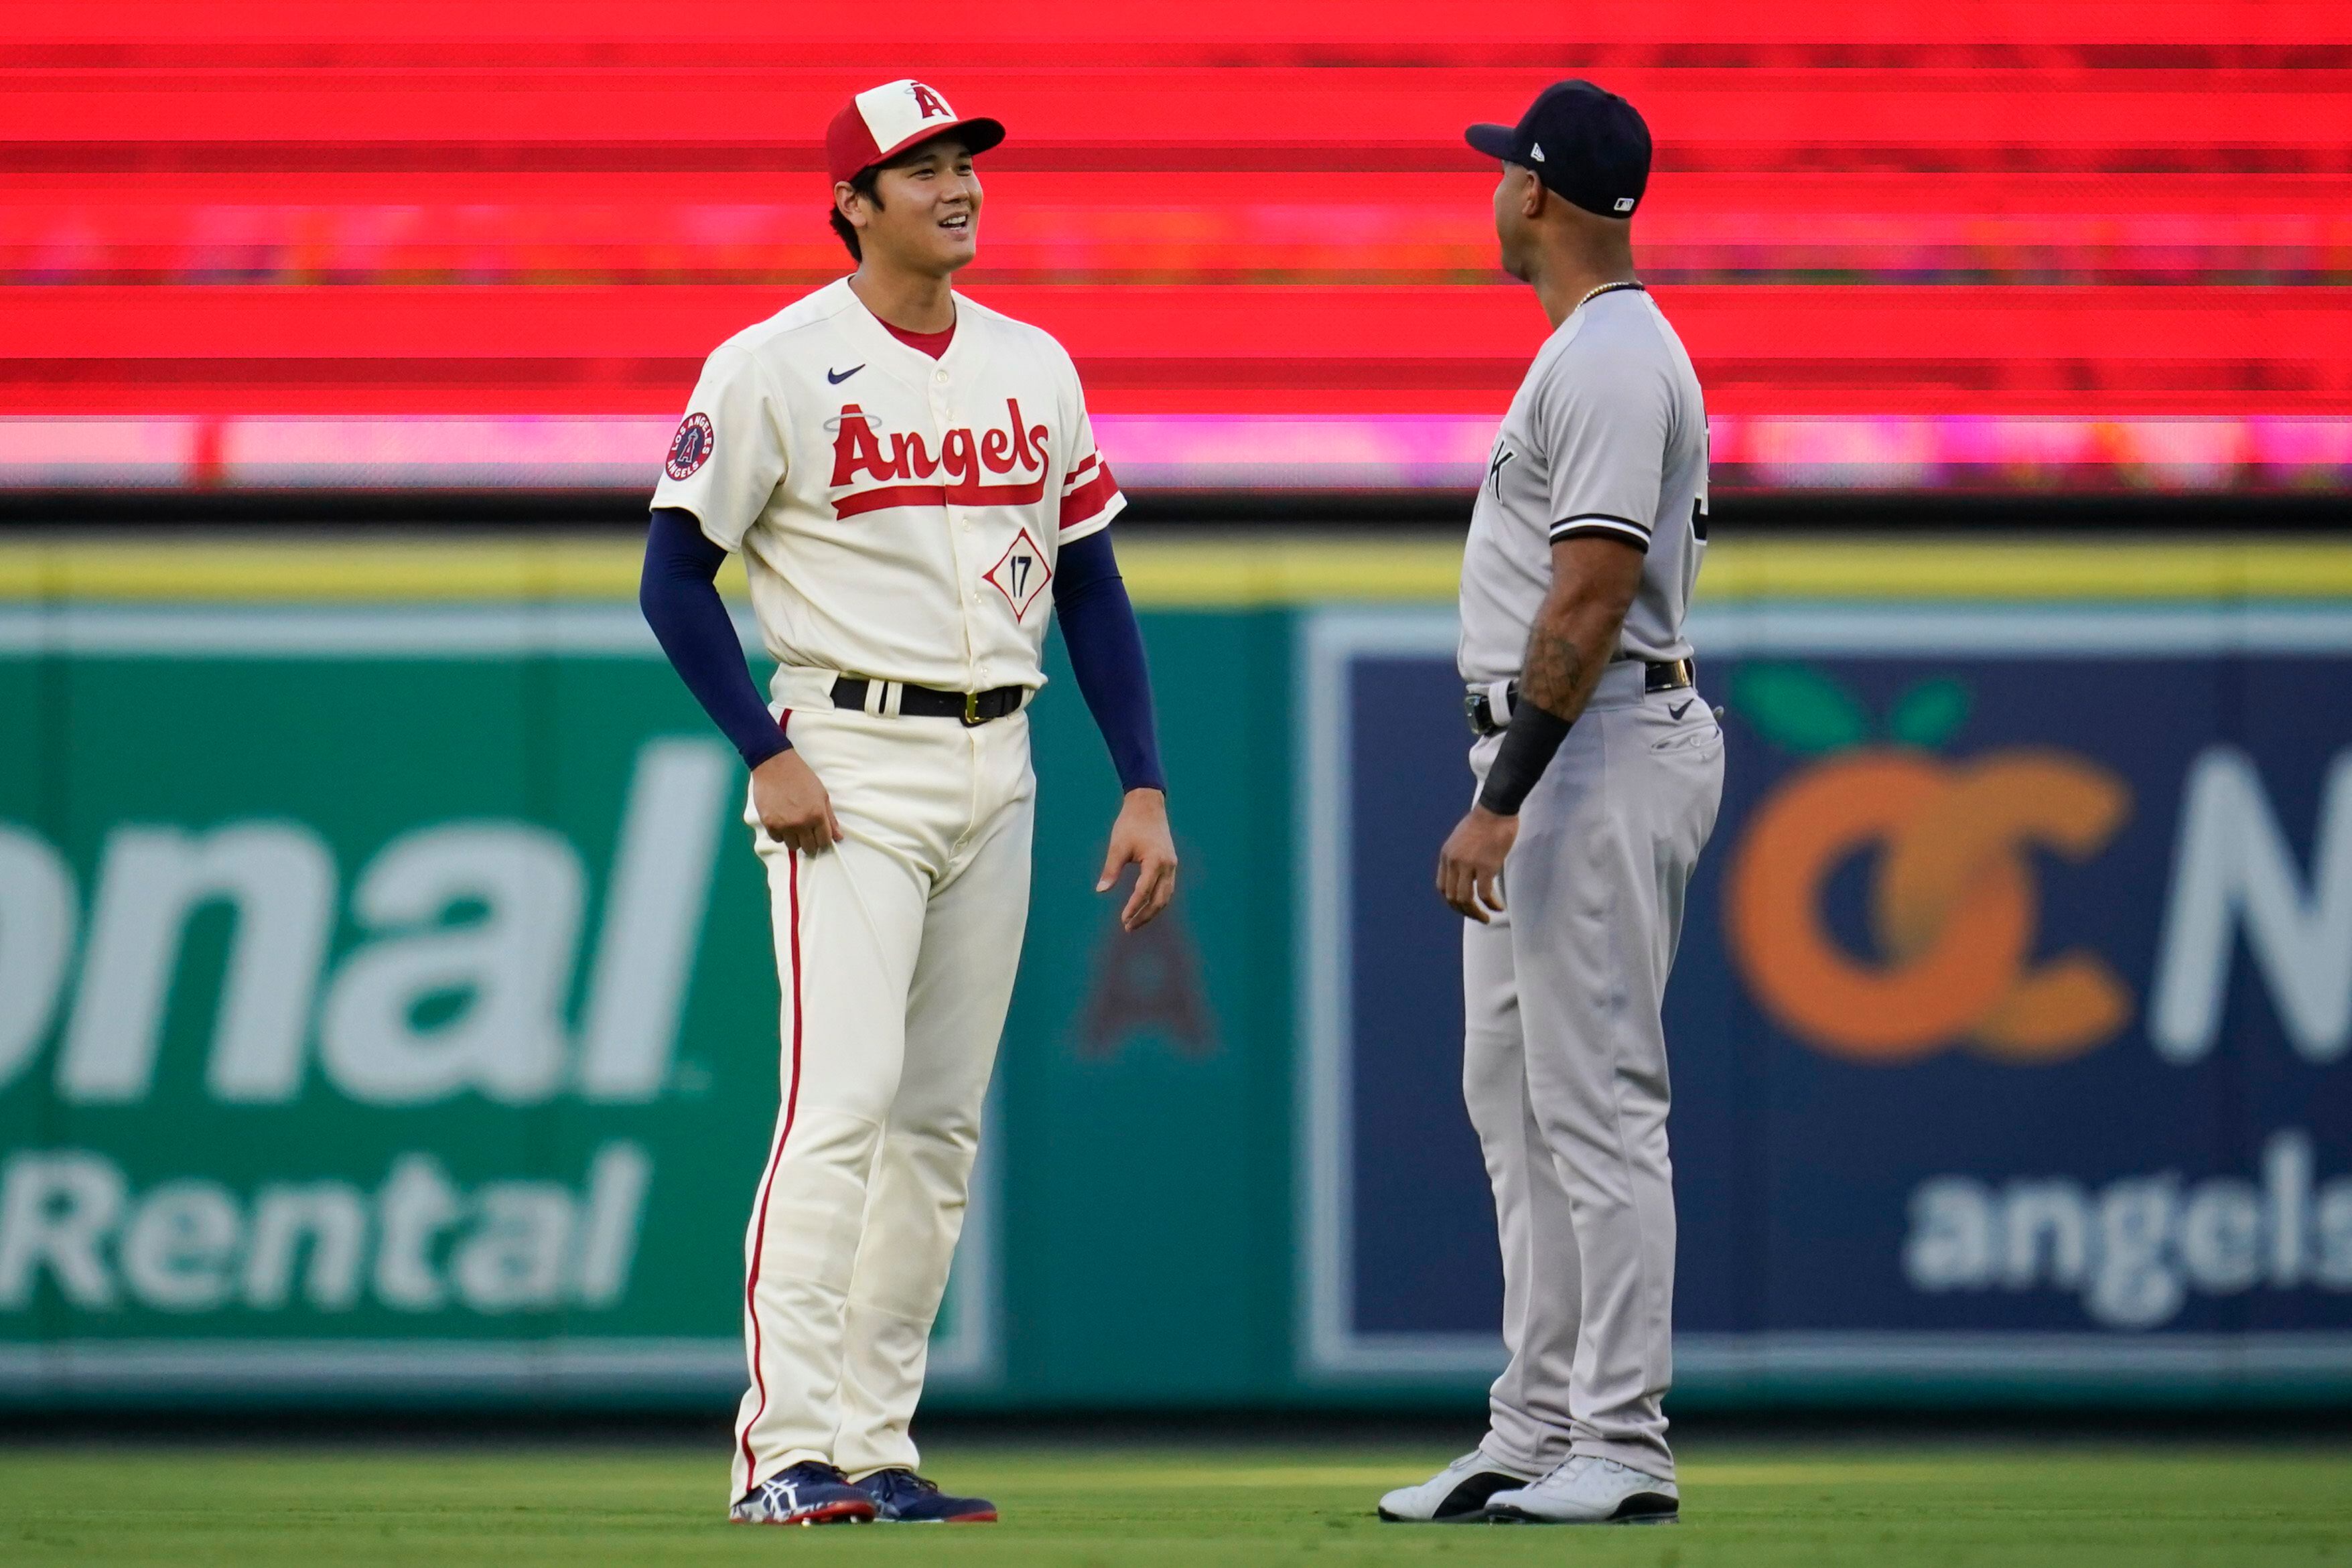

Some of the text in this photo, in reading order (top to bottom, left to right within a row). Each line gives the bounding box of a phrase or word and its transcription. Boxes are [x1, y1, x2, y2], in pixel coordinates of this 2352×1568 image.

[910, 82, 951, 119] A
[671, 415, 712, 455] LOS ANGELES
[677, 429, 699, 463] A
[829, 398, 1048, 507] Angels
[667, 459, 699, 478] ANGELS
[1010, 556, 1032, 598] 17
[2149, 745, 2352, 1064] N
[0, 1137, 650, 1311] Rental
